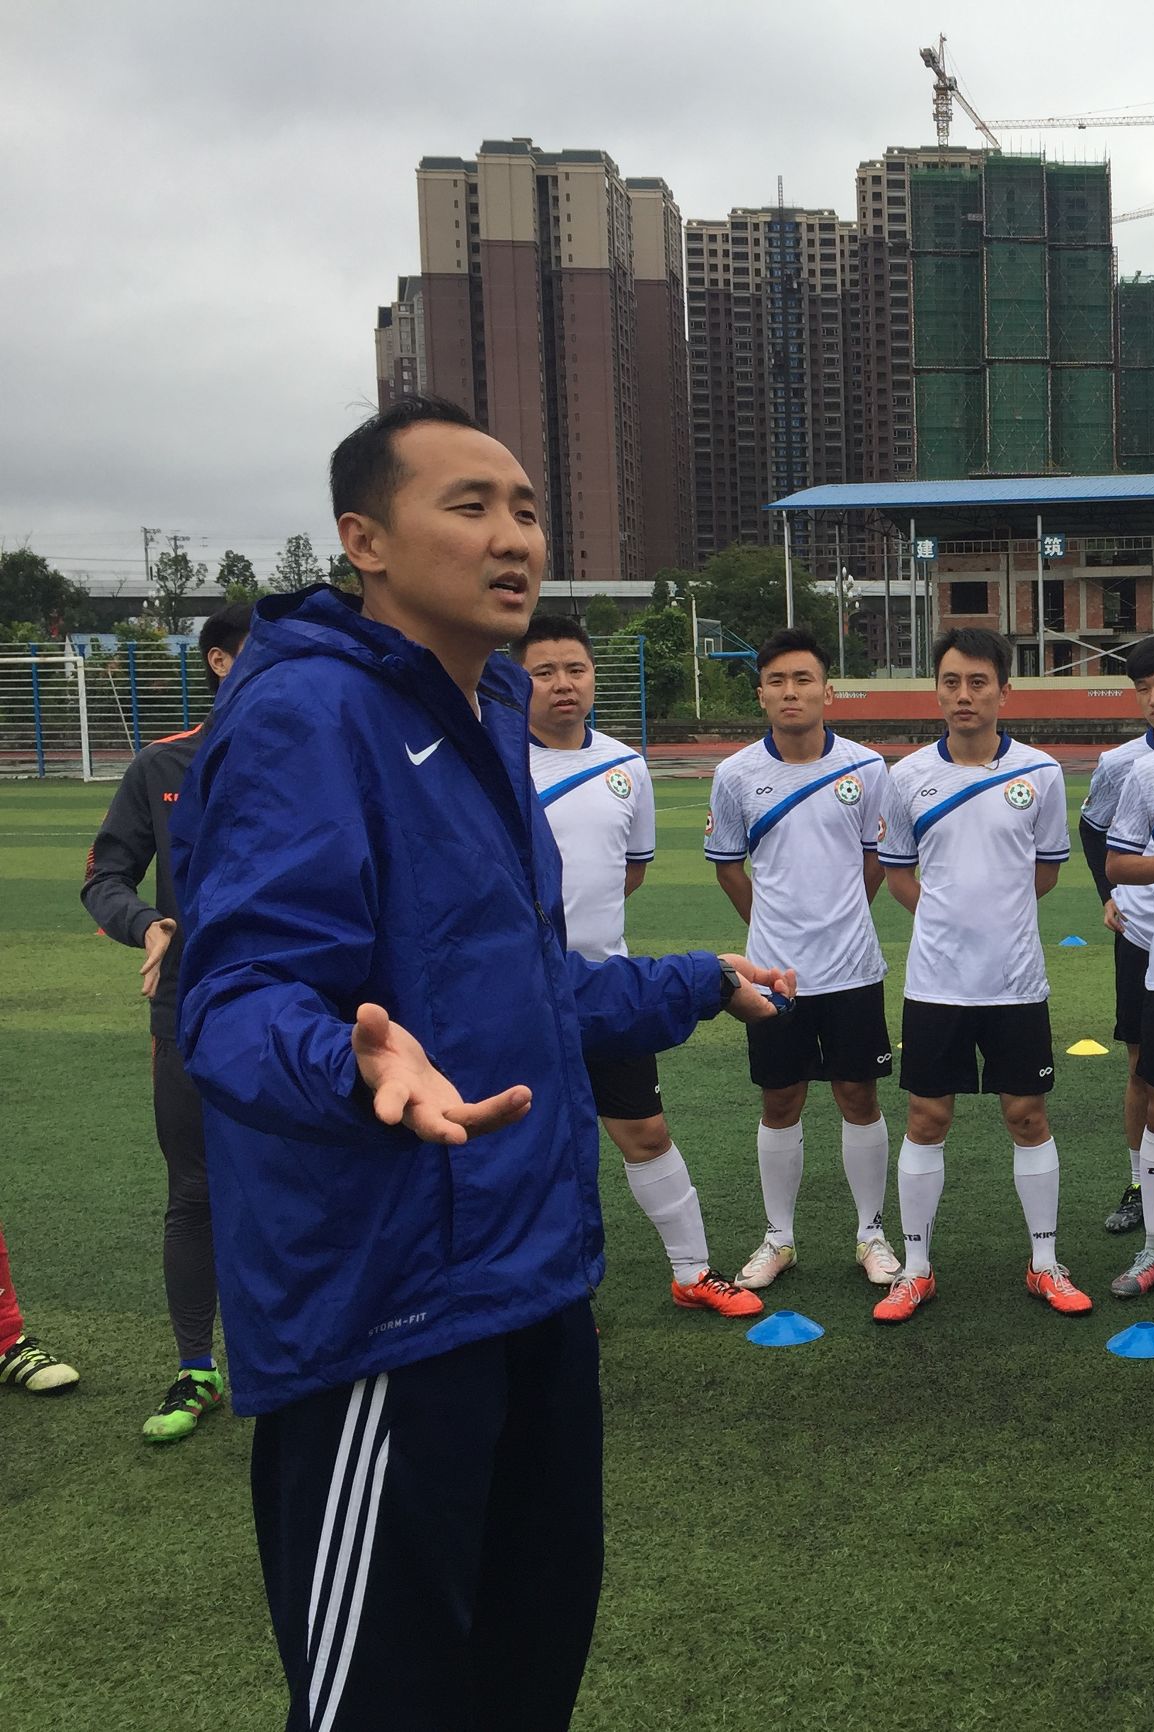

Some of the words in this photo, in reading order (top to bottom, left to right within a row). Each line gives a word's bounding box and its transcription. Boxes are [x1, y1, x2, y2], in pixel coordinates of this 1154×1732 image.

[915, 538, 935, 559] 建
[1043, 536, 1064, 557] 筑
[368, 1312, 427, 1337] STORM-FIT
